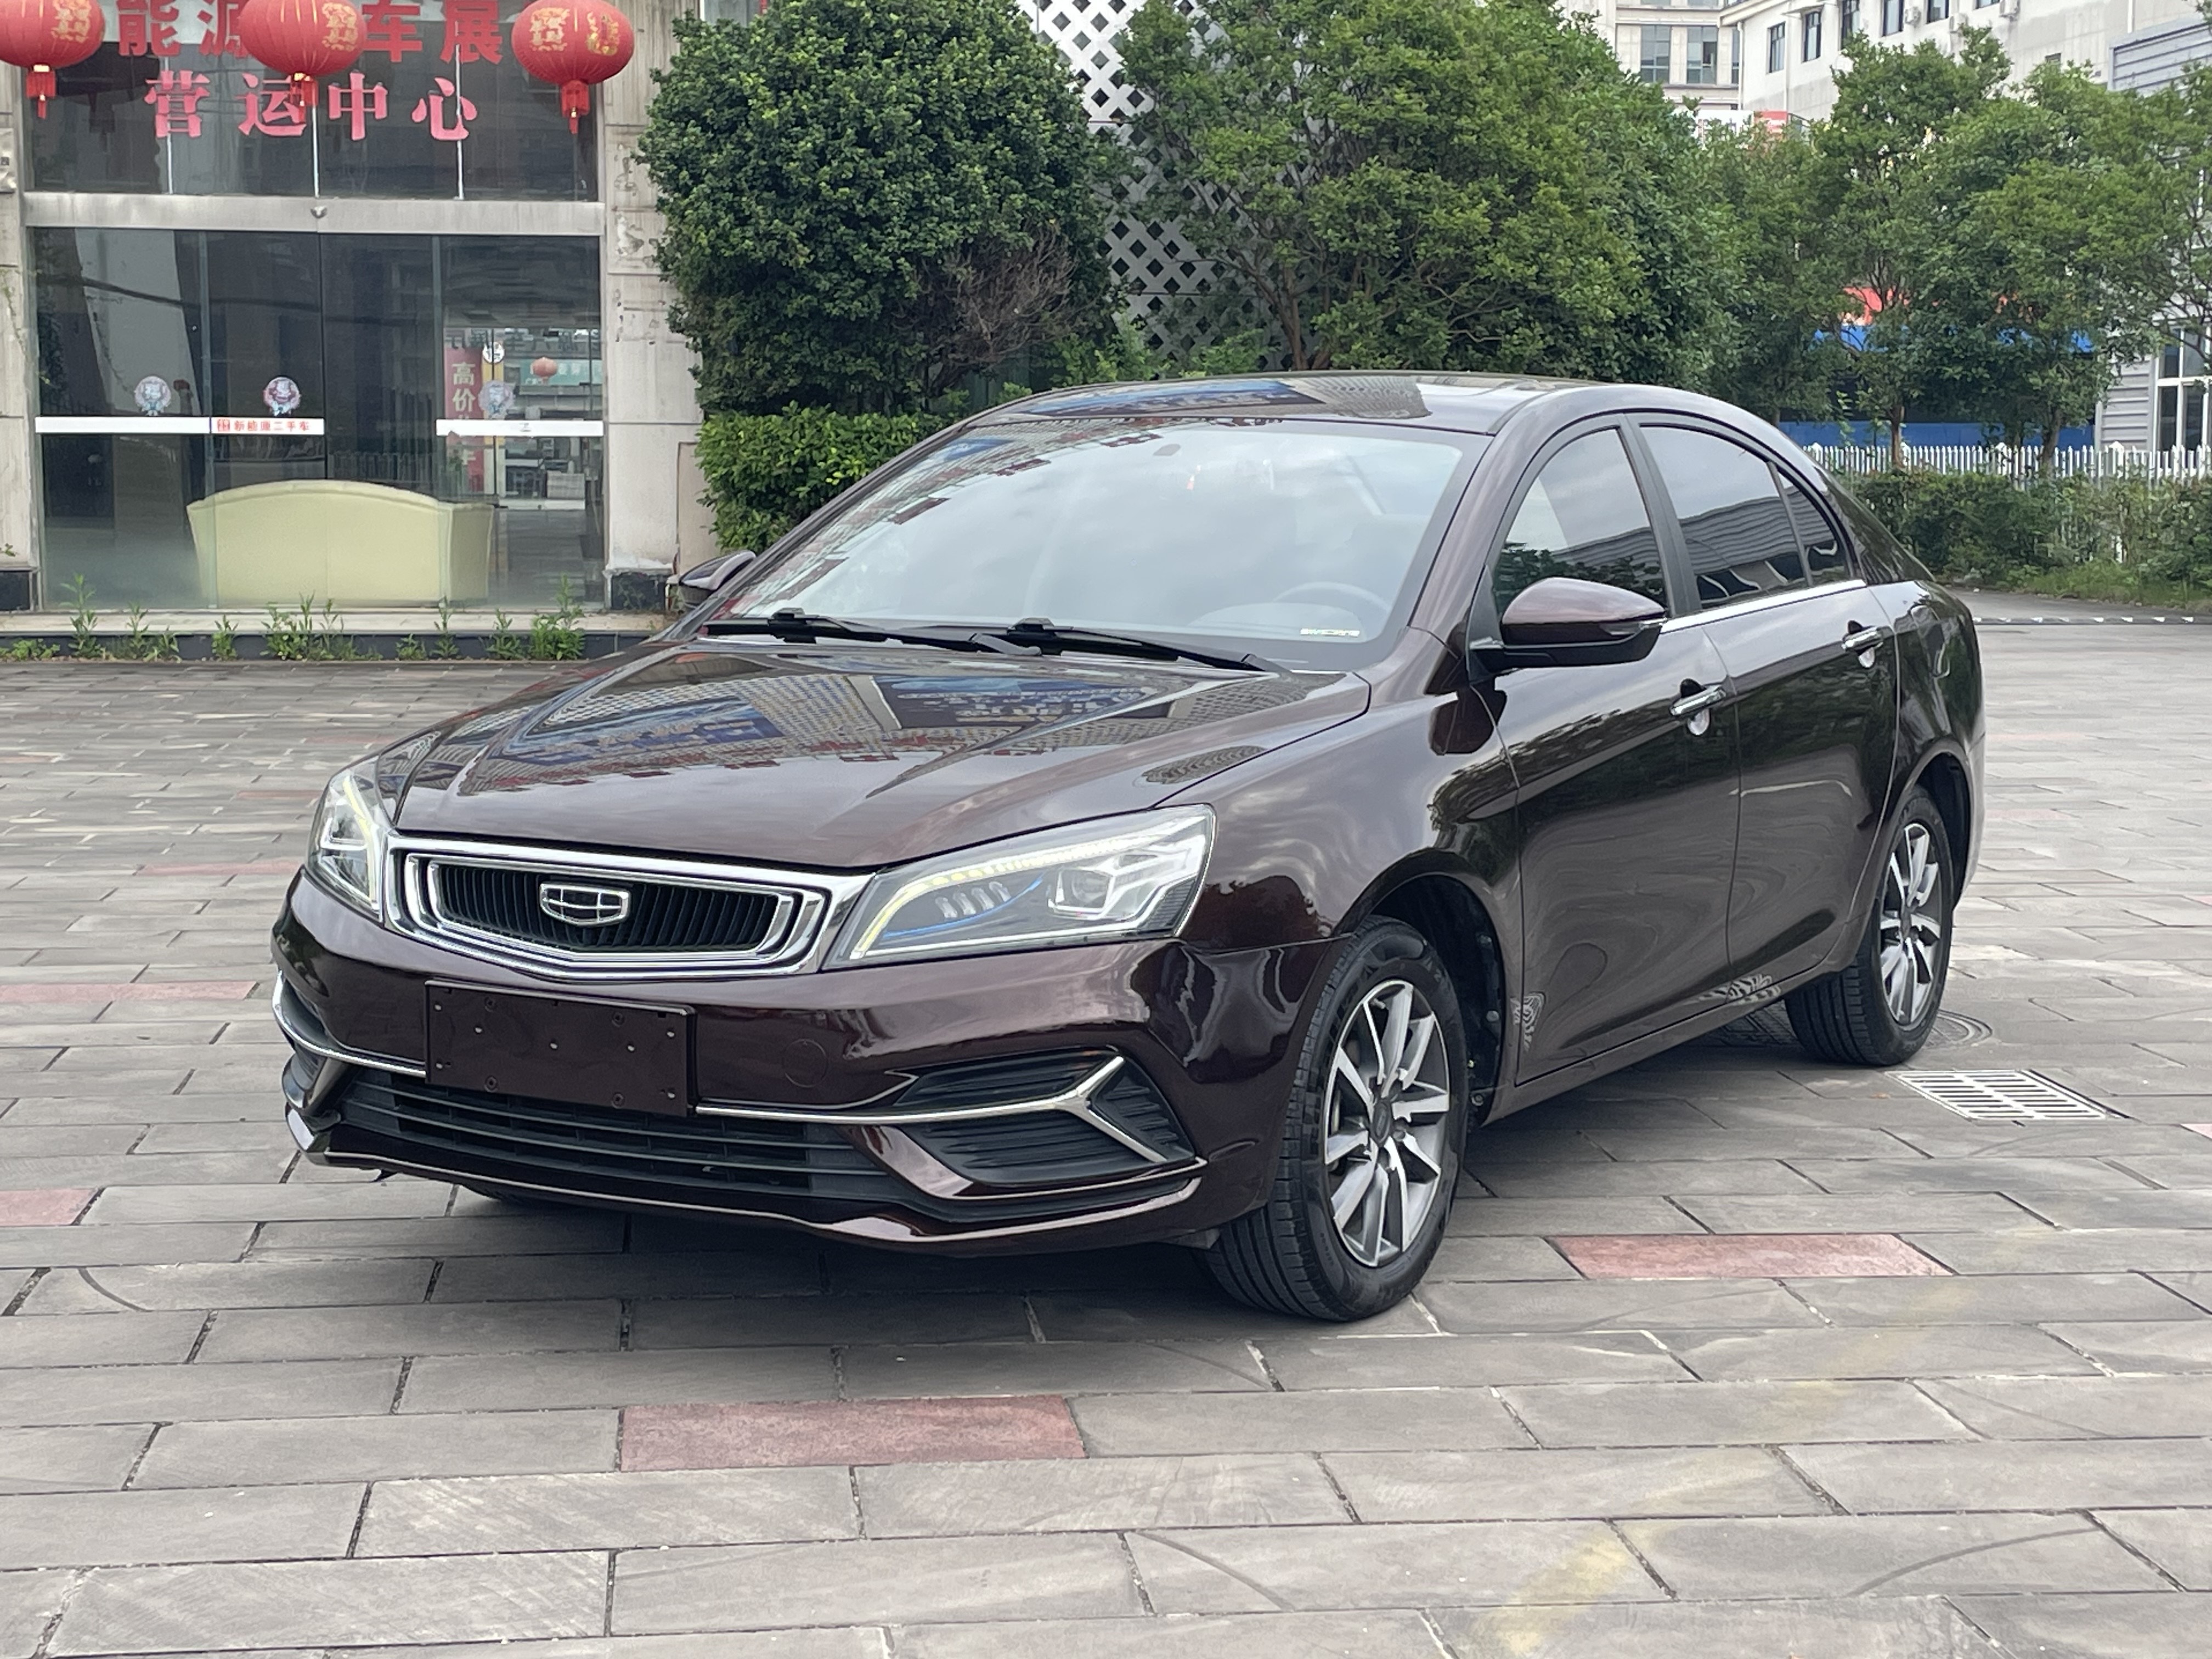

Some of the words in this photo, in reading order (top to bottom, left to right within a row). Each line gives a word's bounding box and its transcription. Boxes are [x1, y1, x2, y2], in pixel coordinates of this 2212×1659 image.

[117, 0, 503, 64] 能源车展
[144, 70, 477, 141] 营运中心
